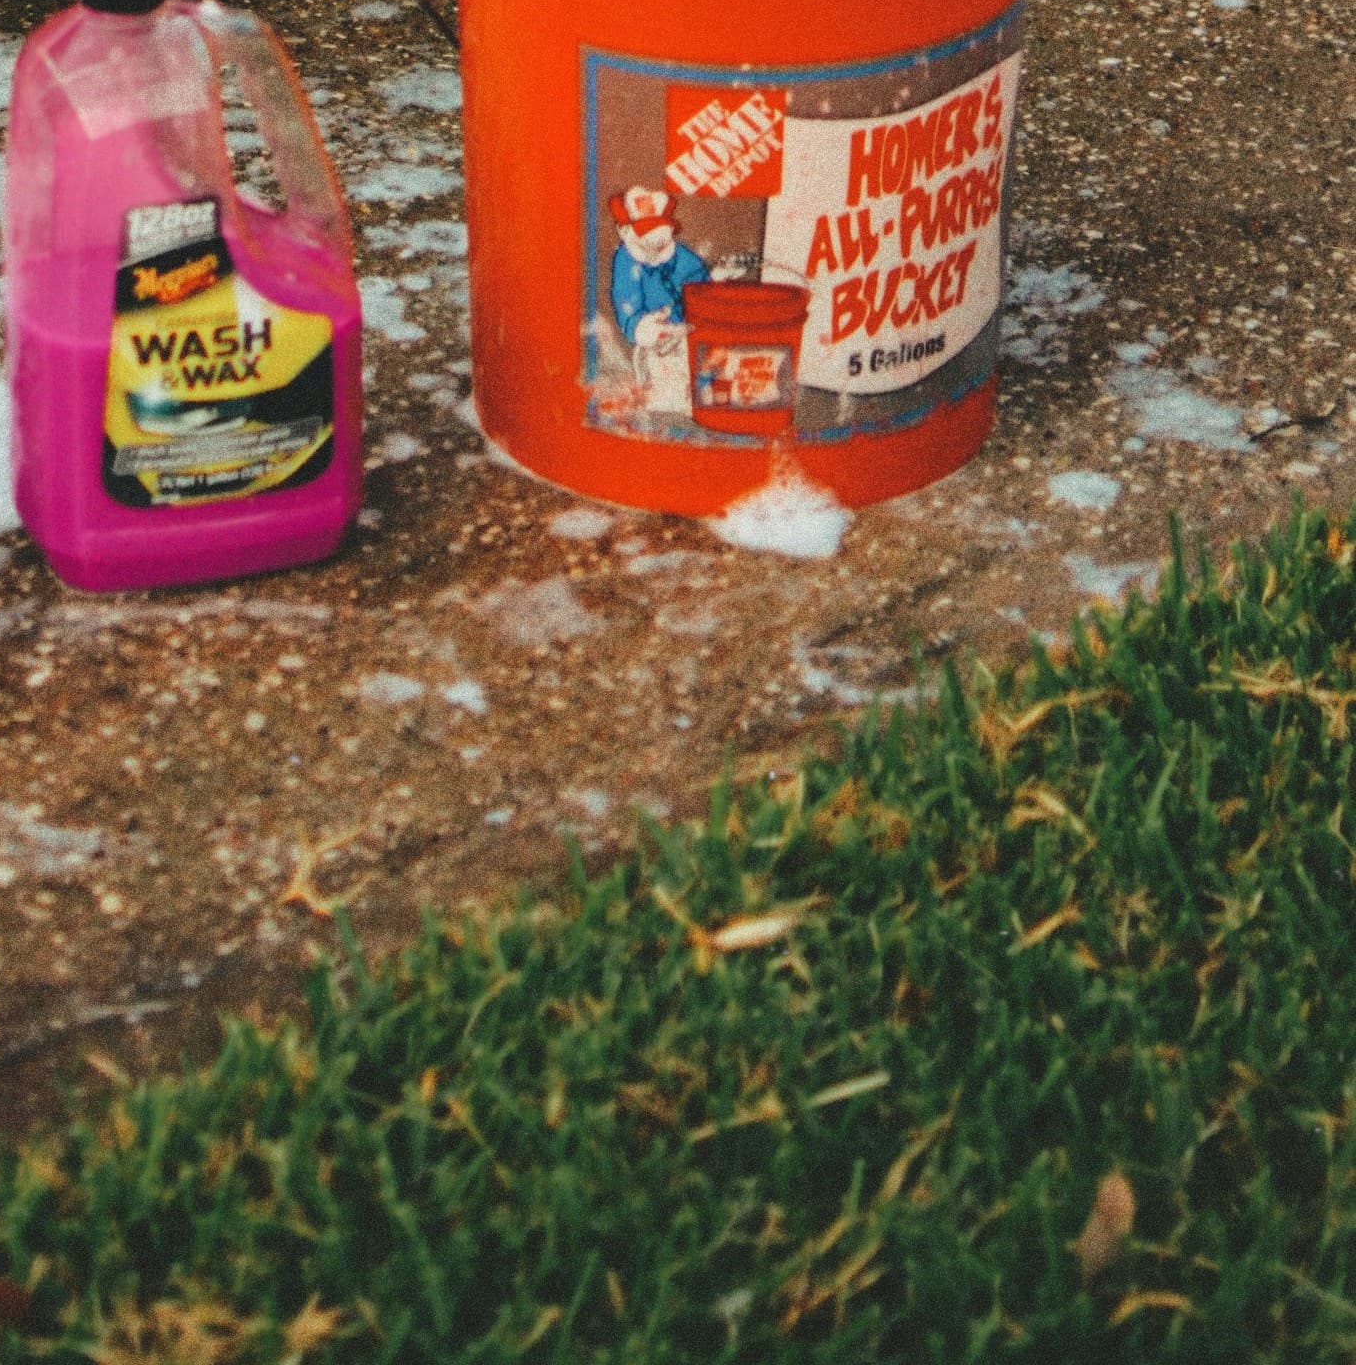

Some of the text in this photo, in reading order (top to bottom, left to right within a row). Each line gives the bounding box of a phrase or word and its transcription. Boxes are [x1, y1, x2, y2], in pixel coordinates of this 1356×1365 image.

[665, 92, 775, 196] HOME
[677, 98, 731, 143] THE
[709, 109, 784, 198] DEPOT
[831, 238, 978, 345] BUCKET
[130, 317, 272, 366] WASH
[848, 330, 947, 377] 5 Gallons
[181, 354, 262, 389] WAX
